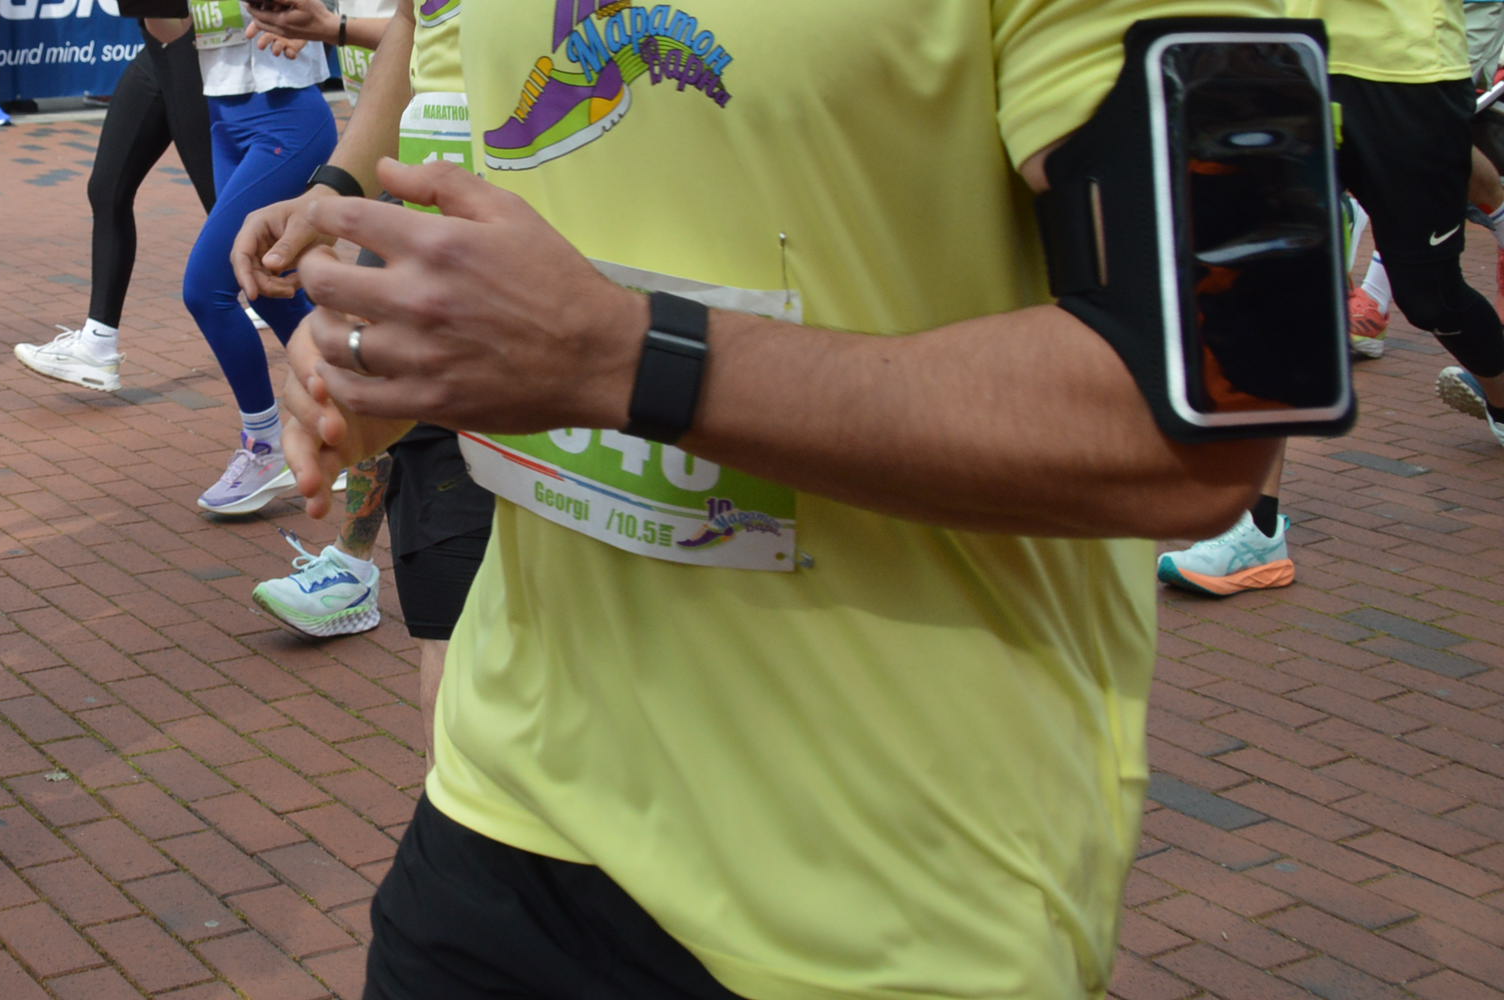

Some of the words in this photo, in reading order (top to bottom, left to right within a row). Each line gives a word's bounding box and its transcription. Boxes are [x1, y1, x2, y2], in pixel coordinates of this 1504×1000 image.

[45, 40, 97, 65] mind,
[566, 4, 734, 84] Маратон
[640, 36, 733, 108] Варна
[534, 480, 591, 521] Georgi
